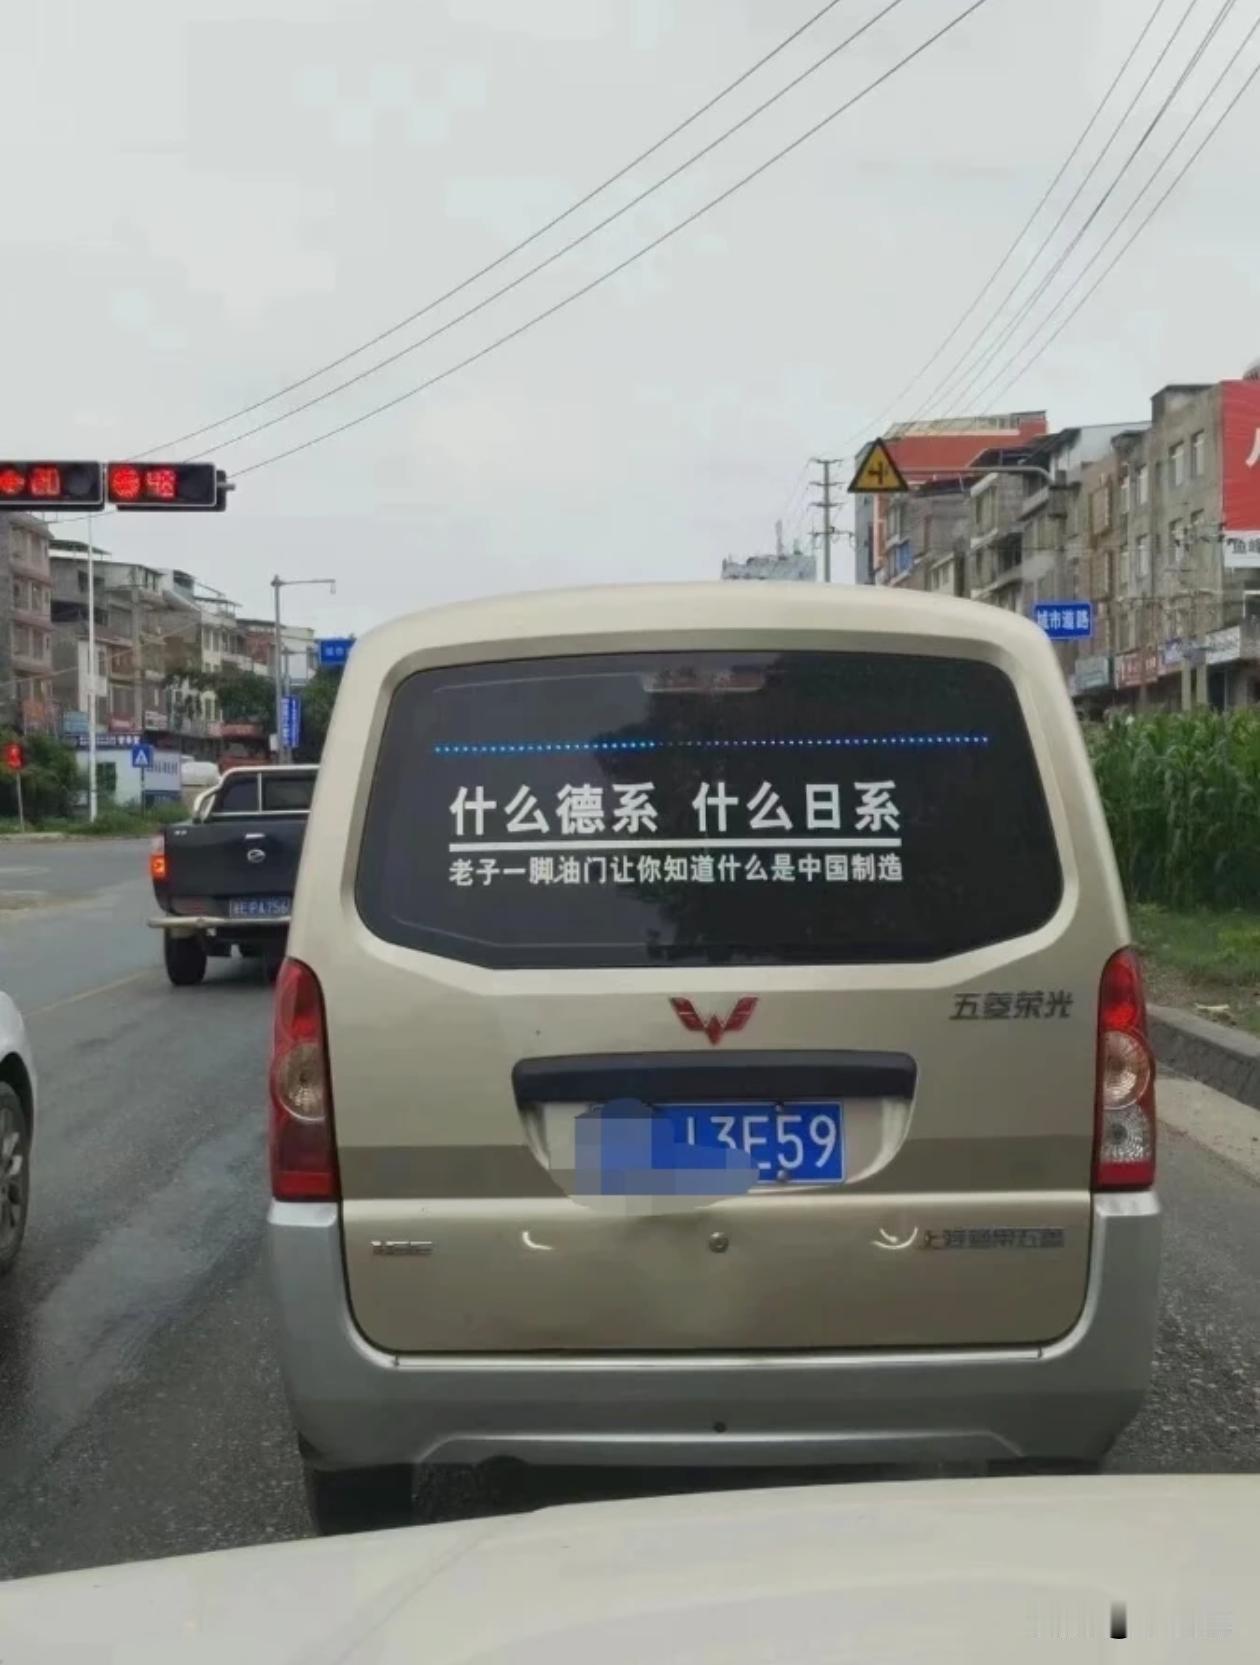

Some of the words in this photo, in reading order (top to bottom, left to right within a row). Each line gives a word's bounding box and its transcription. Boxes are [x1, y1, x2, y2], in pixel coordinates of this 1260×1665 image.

[449, 783, 658, 836] 什么德系
[692, 781, 901, 832] 什么日系
[449, 853, 903, 887] 老子一脚油门让你知道什么是中国制造
[949, 990, 1074, 1020] 五菱荣光
